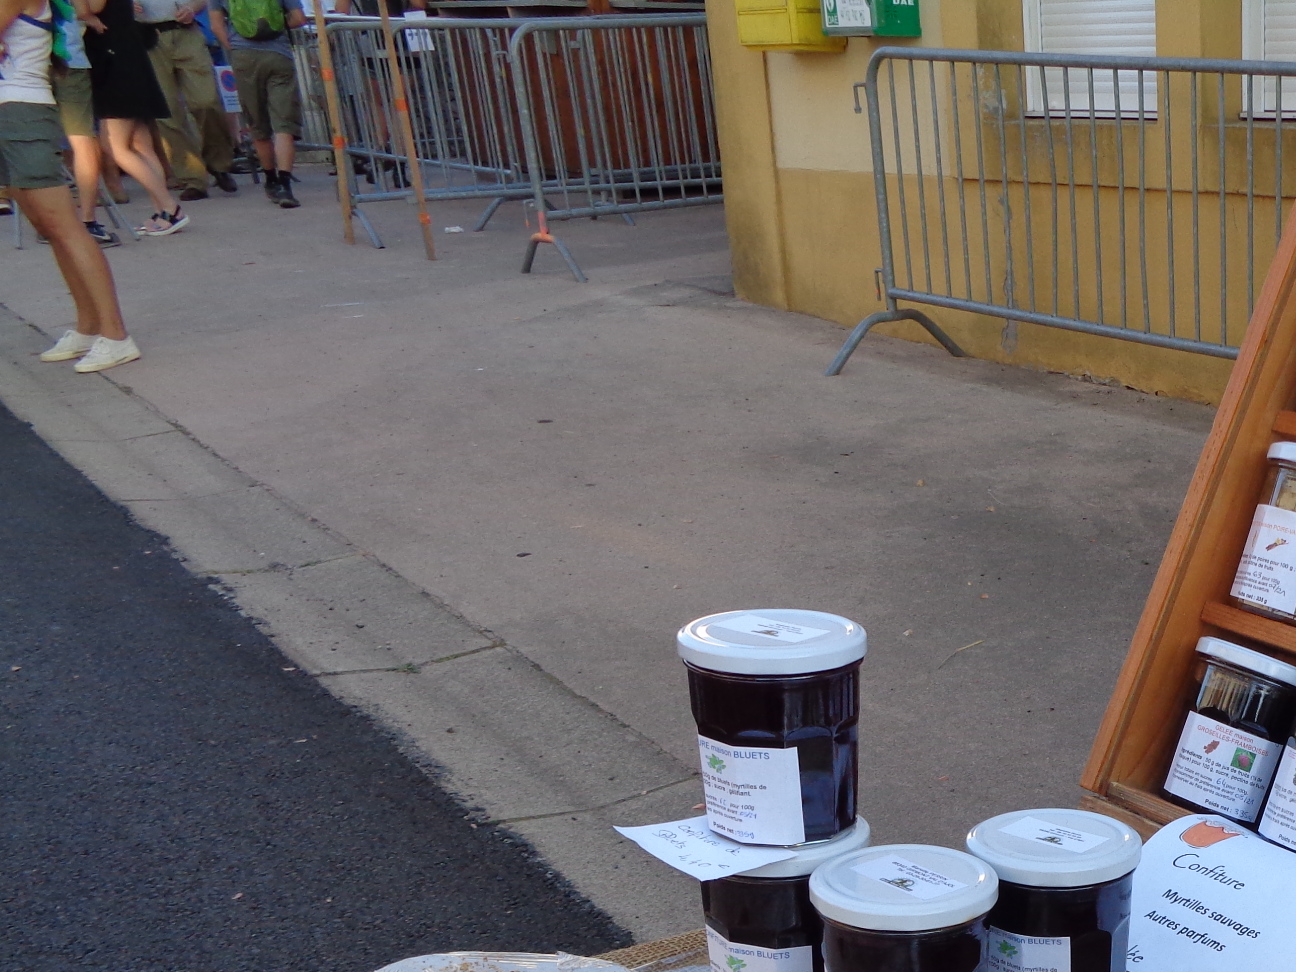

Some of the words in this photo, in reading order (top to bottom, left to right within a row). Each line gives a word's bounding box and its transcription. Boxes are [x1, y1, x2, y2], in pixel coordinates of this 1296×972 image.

[711, 746, 731, 757] maison
[733, 751, 770, 760] BLUETS
[741, 803, 755, 811] 100g
[1220, 805, 1231, 813] net
[726, 827, 735, 835] net
[1172, 853, 1246, 891] Confiture
[1162, 888, 1210, 916] Myrtilles
[1207, 911, 1262, 939] sauvages
[1144, 910, 1180, 931] Autres
[1177, 924, 1227, 953] parfums
[729, 948, 755, 956] maison
[757, 952, 790, 960] BLUETS
[1126, 944, 1144, 964] lée
